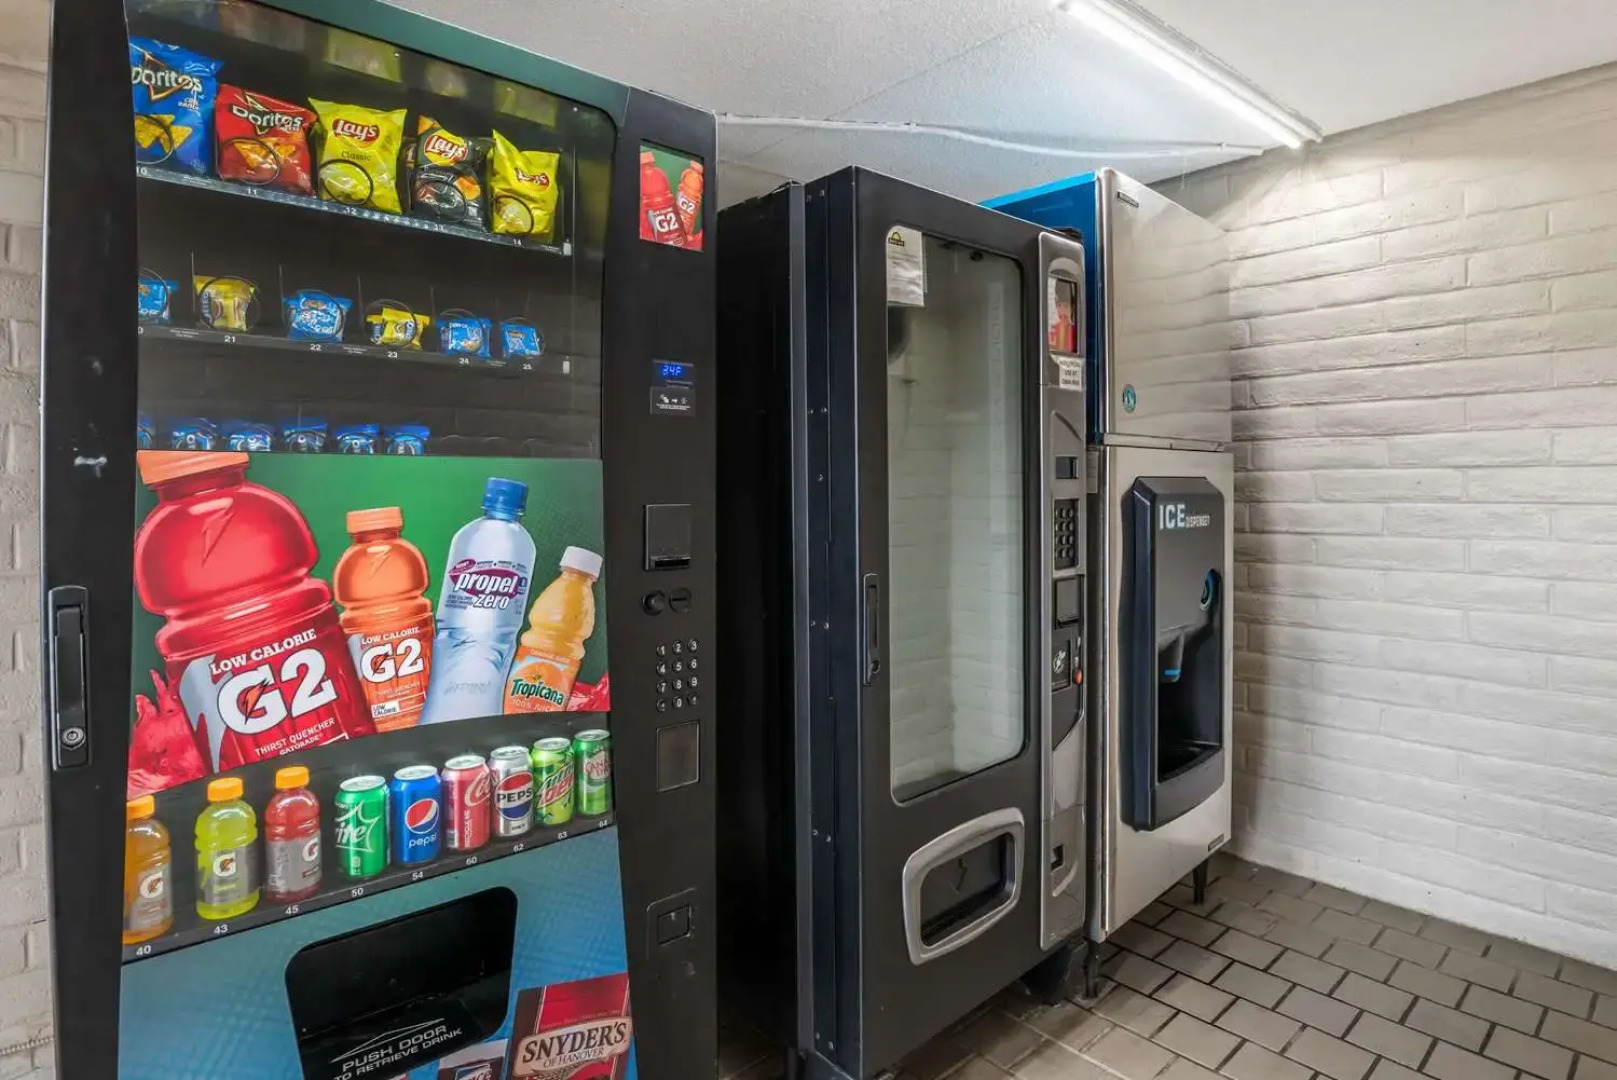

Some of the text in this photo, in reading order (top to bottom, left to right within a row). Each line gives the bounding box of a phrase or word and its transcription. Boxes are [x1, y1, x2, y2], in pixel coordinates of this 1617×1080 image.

[131, 67, 202, 92] Doritos
[232, 104, 303, 127] Doritos
[335, 119, 378, 142] Lay's
[425, 134, 467, 159] Lay's
[341, 150, 371, 162] Classic
[680, 198, 695, 214] G2
[655, 212, 679, 233] G2
[224, 335, 236, 343] 21
[310, 343, 322, 352] 22
[387, 350, 398, 358] 23
[459, 357, 470, 365] 24
[1159, 503, 1185, 530] ICE
[454, 573, 519, 594] propel
[473, 594, 510, 610] zero
[362, 626, 420, 645] LOW CALORIE
[209, 628, 317, 675] LOW CALORIE
[691, 640, 697, 650] 3
[361, 638, 424, 683] G2
[676, 661, 682, 671] 5
[691, 658, 697, 668] 6
[217, 648, 338, 734] G2
[511, 679, 564, 705] Tropicana
[676, 679, 682, 690] 8
[691, 677, 698, 687] 9
[676, 698, 682, 708] 0
[254, 717, 335, 756] THIRST QUENCHER
[279, 734, 320, 756] GATORADE
[497, 788, 532, 803] PEPS
[409, 832, 437, 849] pepsi
[513, 843, 524, 851] 62
[212, 852, 236, 877] G
[466, 856, 478, 865] 60
[412, 871, 424, 880] 54
[139, 871, 164, 899] G
[351, 887, 364, 897] 50
[285, 905, 299, 915] 45
[214, 924, 228, 935] 43
[136, 945, 151, 957] 40
[342, 1024, 447, 1072] PUSH DOOR
[522, 1020, 627, 1063] SNYDER'S
[356, 1045, 418, 1075] RETRIEVE
[422, 1028, 463, 1049] DRINK
[543, 1046, 604, 1068] OF HANOVER
